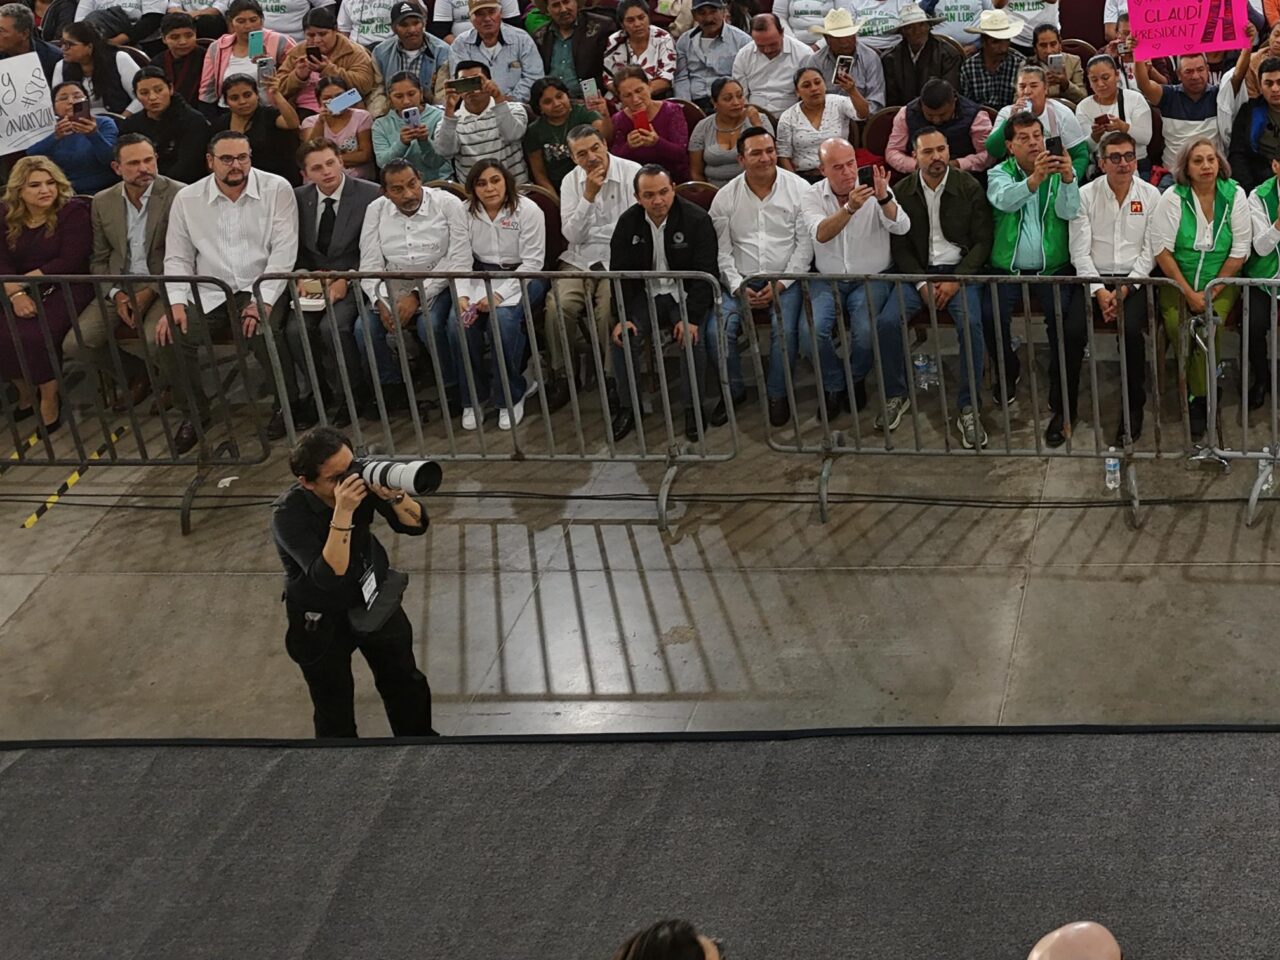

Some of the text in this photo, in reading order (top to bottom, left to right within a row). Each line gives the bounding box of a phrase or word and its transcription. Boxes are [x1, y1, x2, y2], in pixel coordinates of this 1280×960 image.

[1008, 0, 1045, 12] SAN LUIS
[938, 11, 975, 22] SAN LUIS
[1132, 204, 1141, 212] PT
